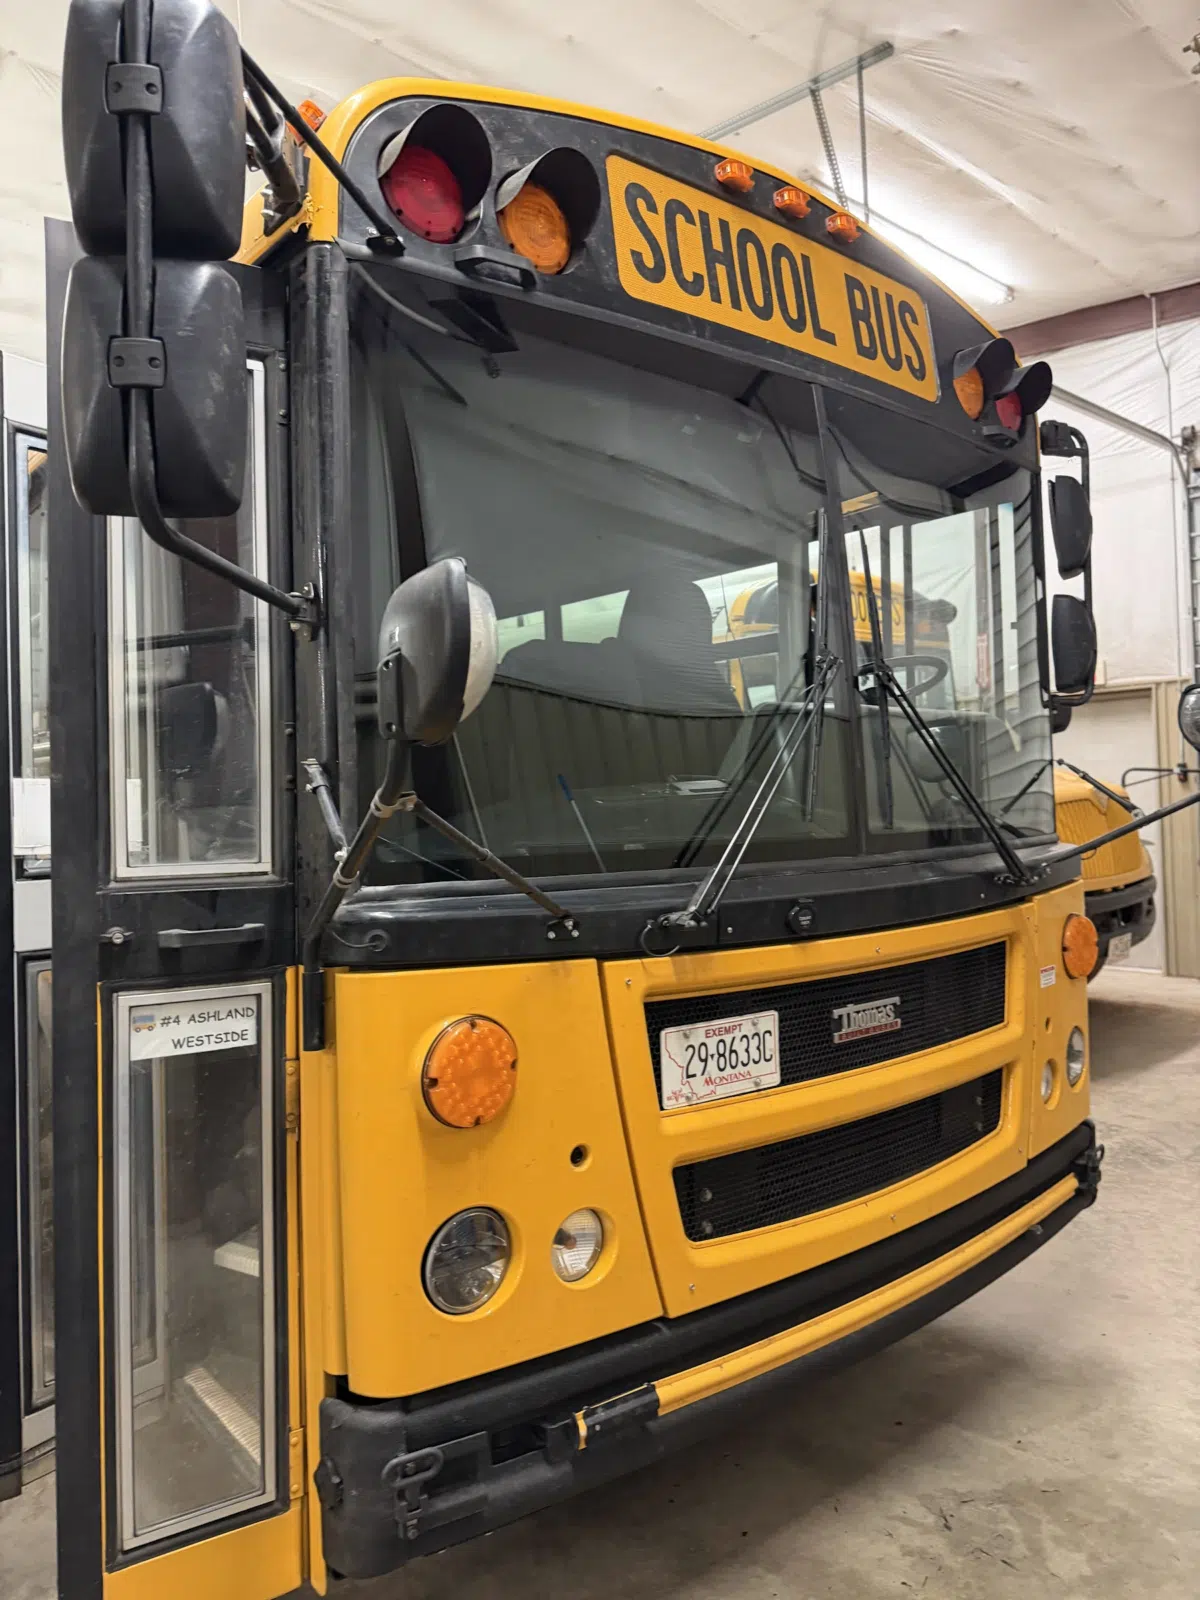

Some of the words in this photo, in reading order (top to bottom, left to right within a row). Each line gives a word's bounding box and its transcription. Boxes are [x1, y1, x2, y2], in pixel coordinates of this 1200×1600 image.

[624, 182, 837, 346] SCHOOL
[844, 272, 927, 382] BUS
[160, 1015, 181, 1027] #4
[187, 1007, 255, 1025] ASHLAND
[832, 996, 901, 1033] Thomas
[172, 1029, 249, 1049] WESTSIDE
[704, 1023, 743, 1039] EXEMPT
[703, 1070, 752, 1087] MONTANA
